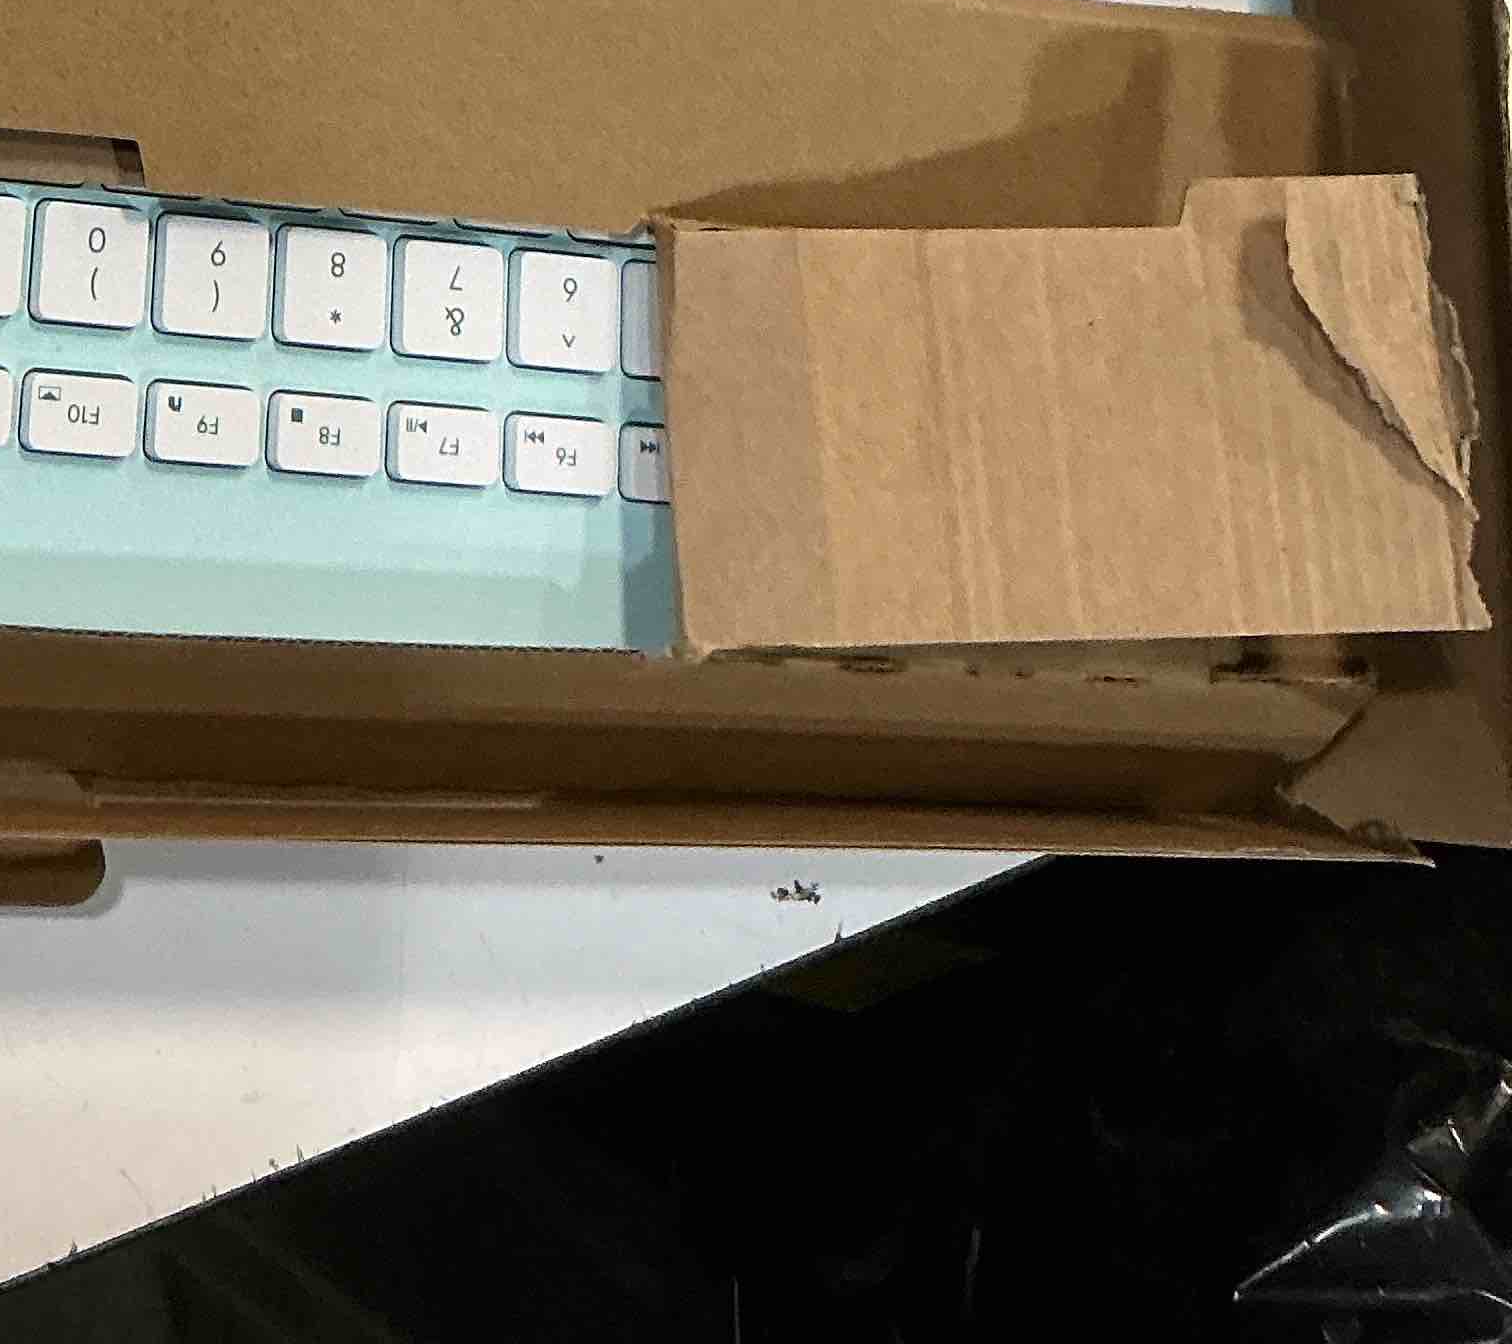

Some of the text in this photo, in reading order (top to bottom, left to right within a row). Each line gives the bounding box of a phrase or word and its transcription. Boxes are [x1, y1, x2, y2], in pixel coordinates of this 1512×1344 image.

[88, 227, 106, 254] 0
[210, 240, 226, 267] 9
[330, 252, 346, 278] 8
[449, 265, 463, 291] 7
[563, 277, 578, 303] 6
[445, 307, 465, 337] &
[67, 403, 100, 425] F10
[196, 415, 219, 436] F9
[319, 426, 341, 446] F8
[438, 437, 460, 457] F7
[555, 447, 577, 467] F6
